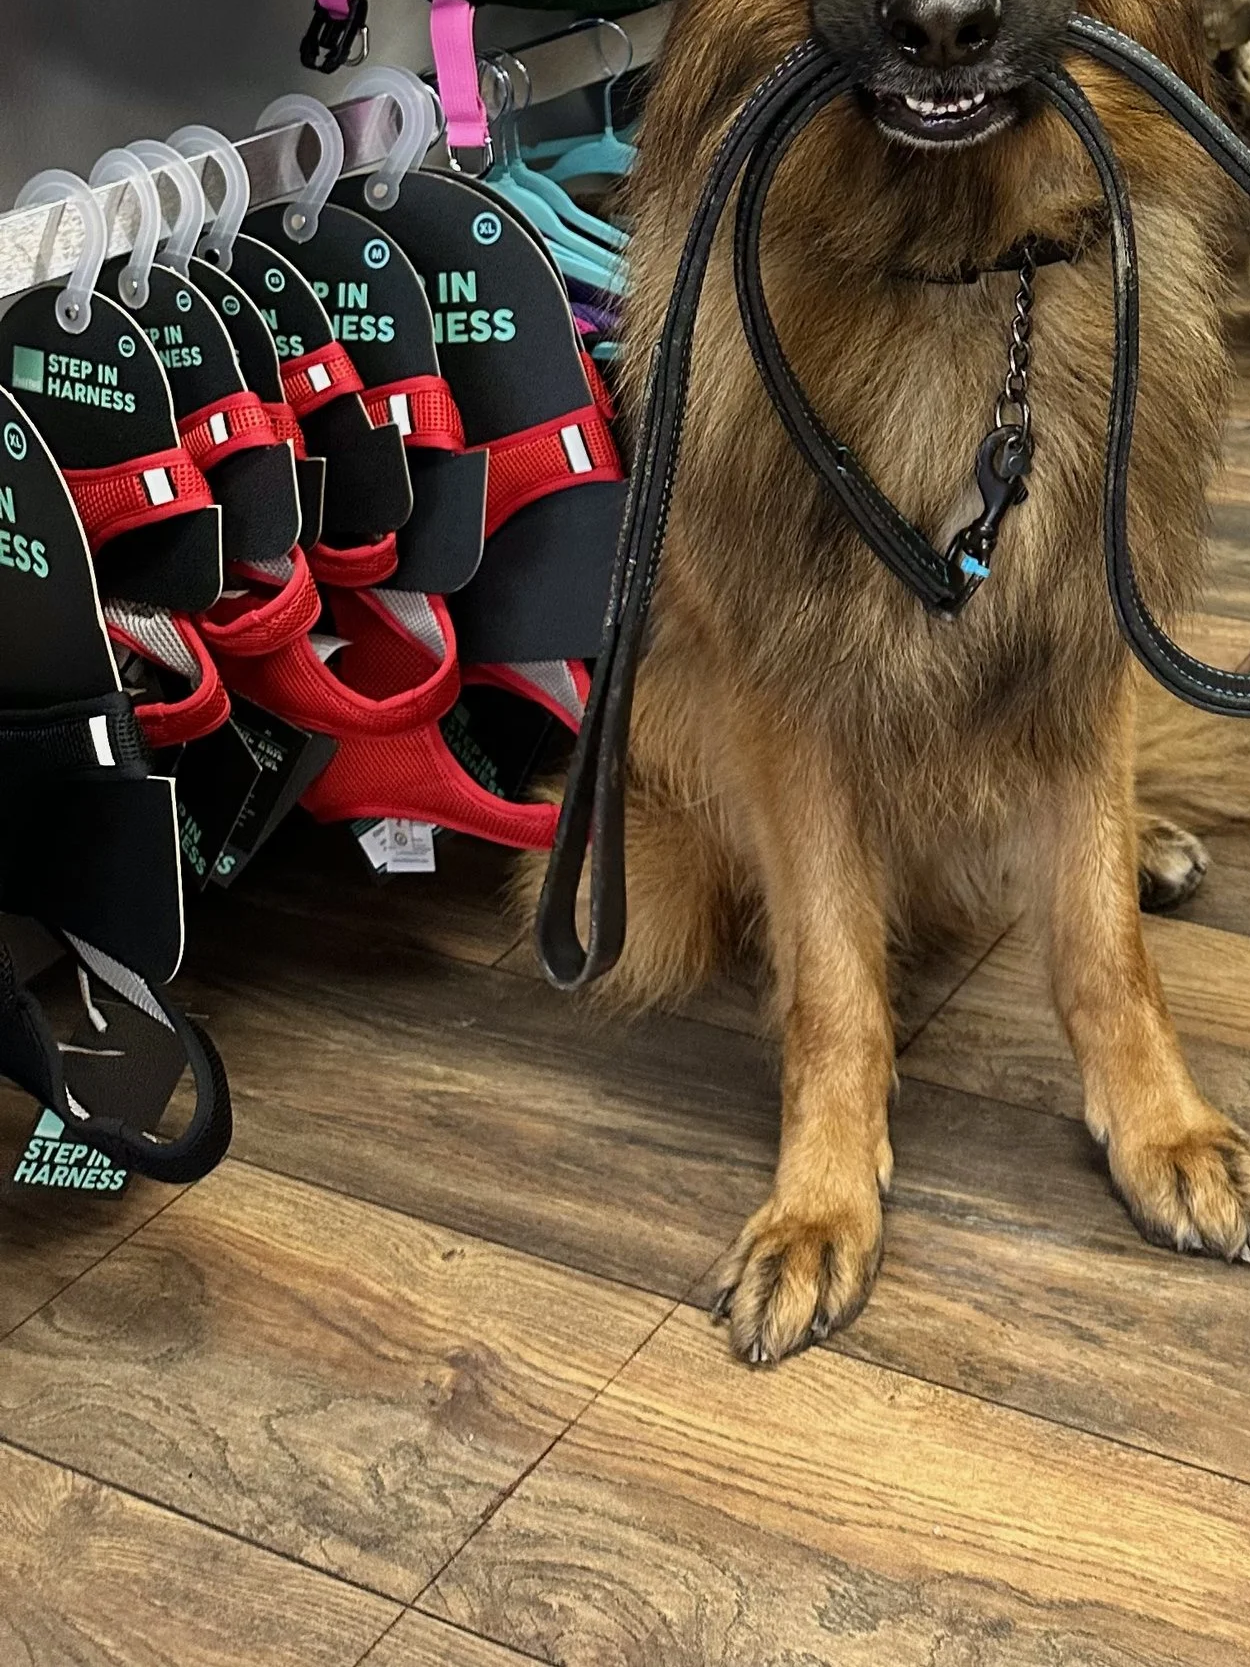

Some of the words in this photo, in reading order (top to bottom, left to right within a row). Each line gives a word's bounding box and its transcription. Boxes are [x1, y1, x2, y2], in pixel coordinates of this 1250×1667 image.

[479, 223, 494, 234] XL
[338, 282, 368, 309] IN
[439, 270, 477, 304] IN
[164, 325, 183, 345] IN
[48, 354, 93, 380] STEP
[98, 364, 118, 387] IN
[47, 376, 136, 413] HARNESS
[9, 433, 22, 449] XL
[24, 1138, 88, 1165] STEP
[14, 1160, 127, 1190] HARNESS
